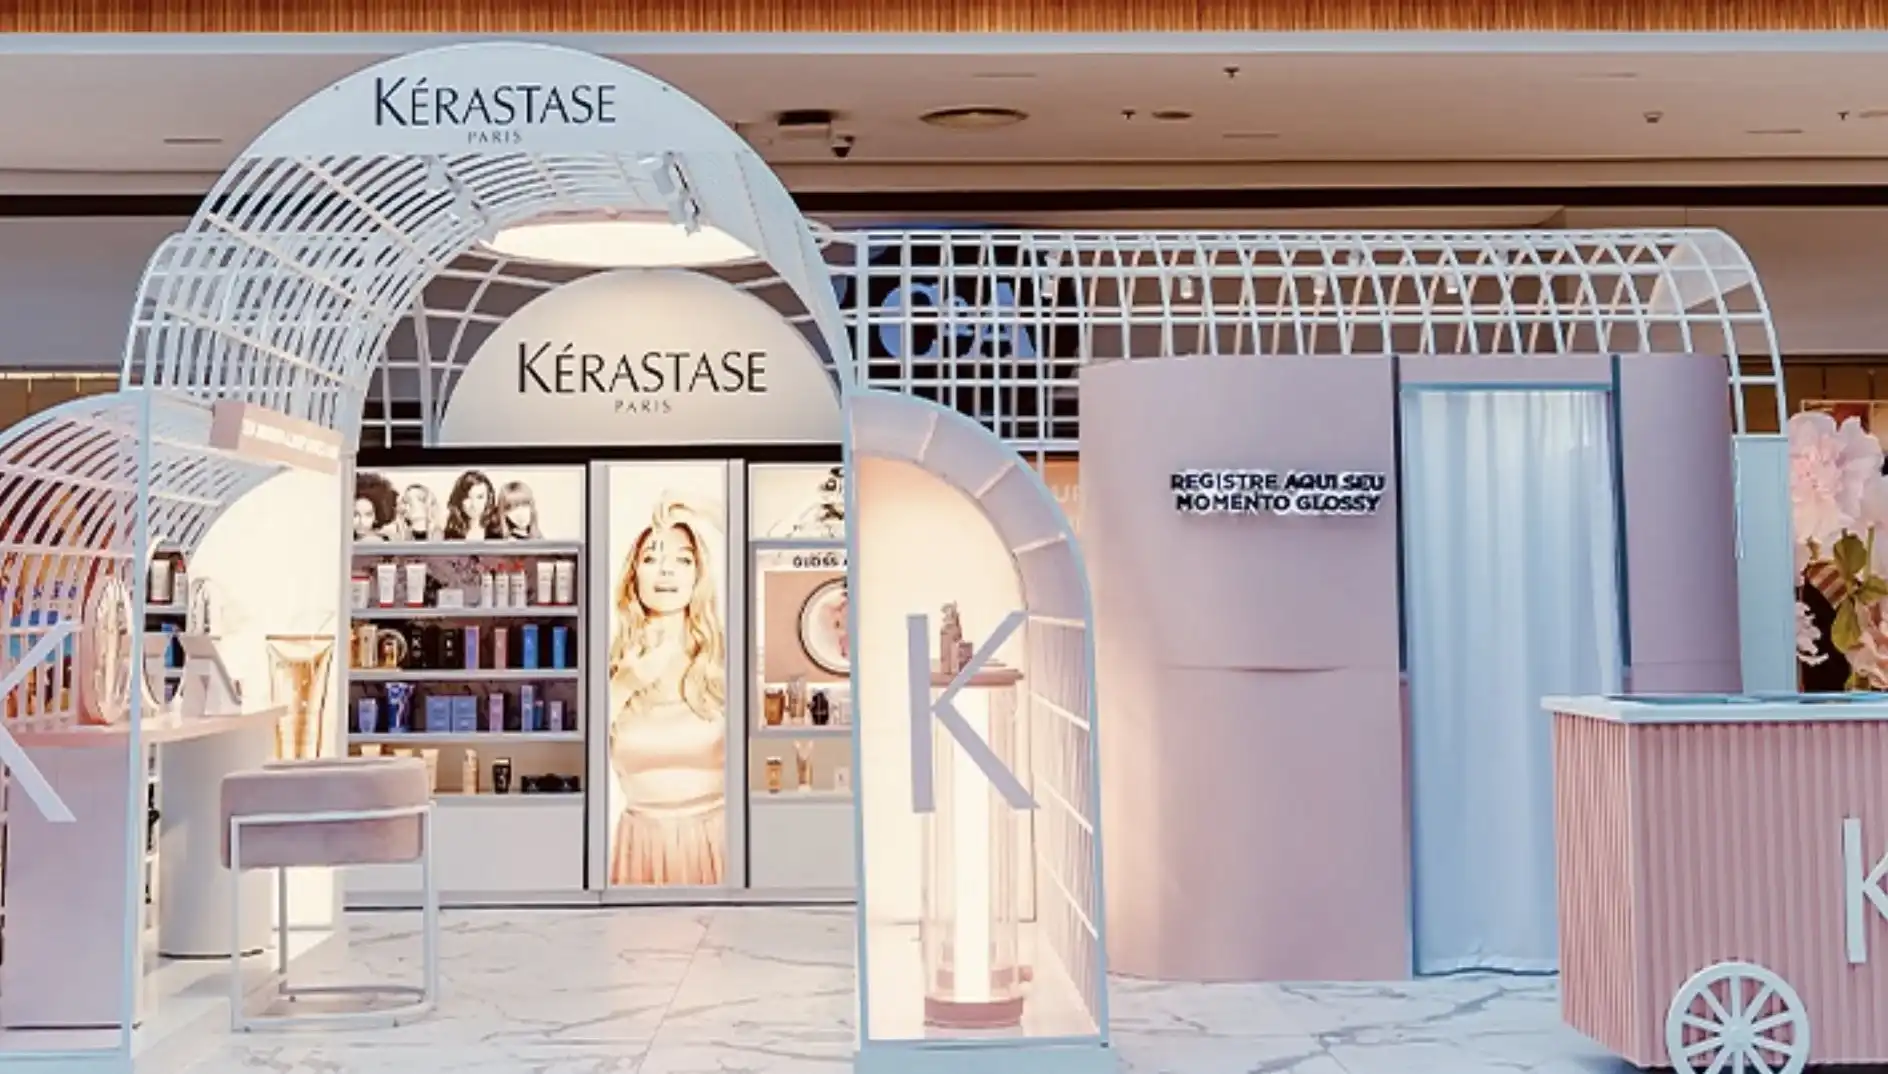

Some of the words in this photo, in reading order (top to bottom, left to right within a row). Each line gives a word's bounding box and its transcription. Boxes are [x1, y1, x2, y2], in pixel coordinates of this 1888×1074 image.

[374, 76, 616, 126] KÉRASTASE
[467, 131, 523, 144] PARIS
[518, 341, 768, 393] KÉRASTASE
[614, 400, 673, 413] PARIS
[1170, 473, 1278, 489] REGISTRE
[1284, 473, 1337, 490] AQUI
[1342, 473, 1386, 491] SEU
[1176, 495, 1290, 510] MOMENTO
[1296, 495, 1381, 511] GLOSSY
[906, 611, 1040, 814] K
